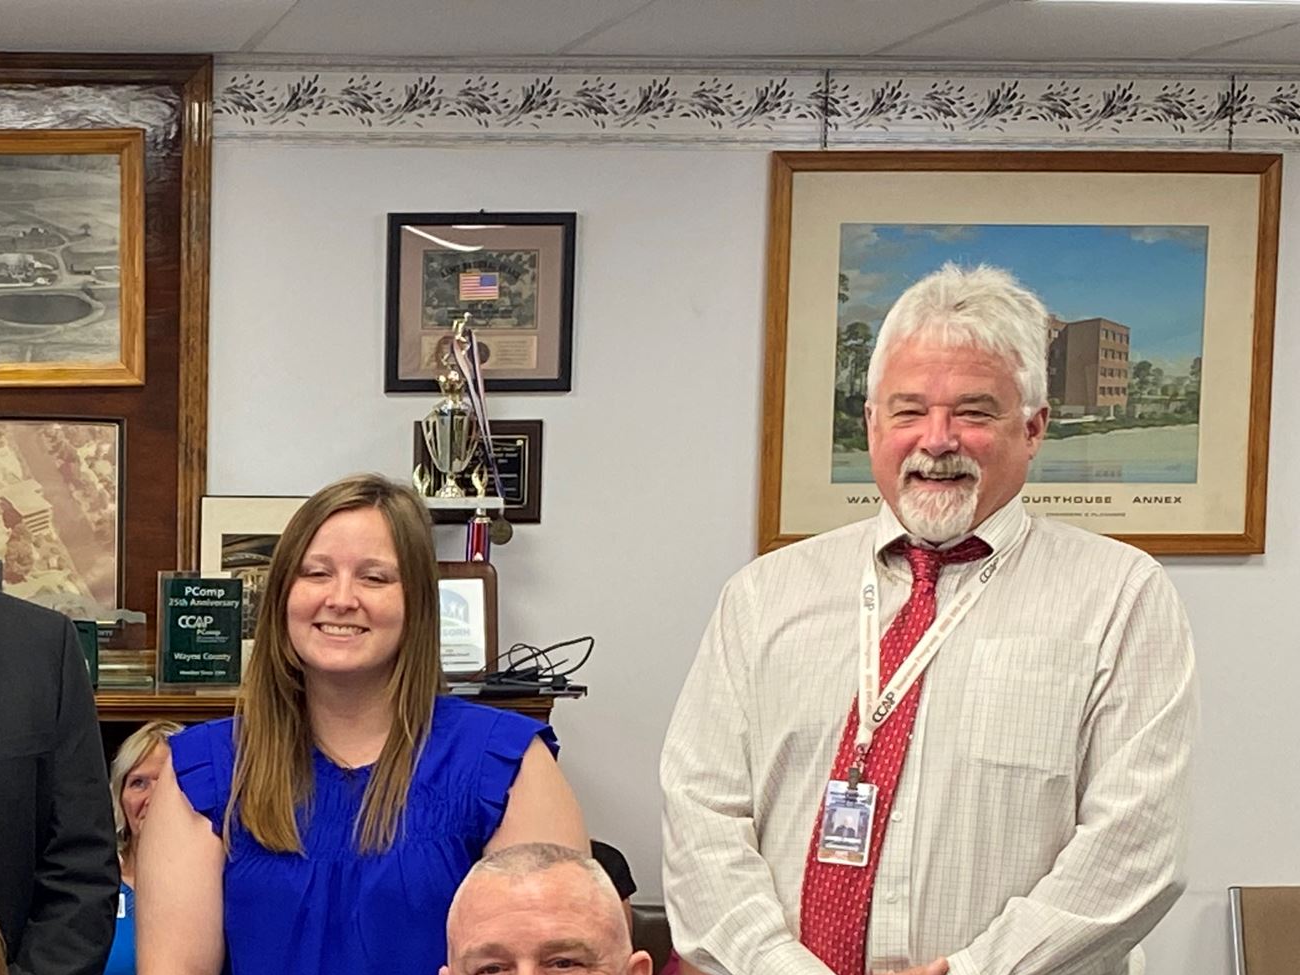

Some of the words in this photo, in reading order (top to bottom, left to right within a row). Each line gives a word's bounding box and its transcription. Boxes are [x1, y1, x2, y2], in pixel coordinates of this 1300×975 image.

[846, 496, 881, 504] WAY
[1021, 496, 1112, 504] OURTHOUSE
[1132, 496, 1182, 504] ANNEX
[185, 586, 225, 598] PComp
[863, 584, 875, 611] CCAP
[190, 599, 239, 609] Anniversary
[178, 616, 213, 628] CCAP
[174, 653, 200, 661] Wayne
[203, 653, 231, 661] County
[872, 692, 895, 723] CCAP
